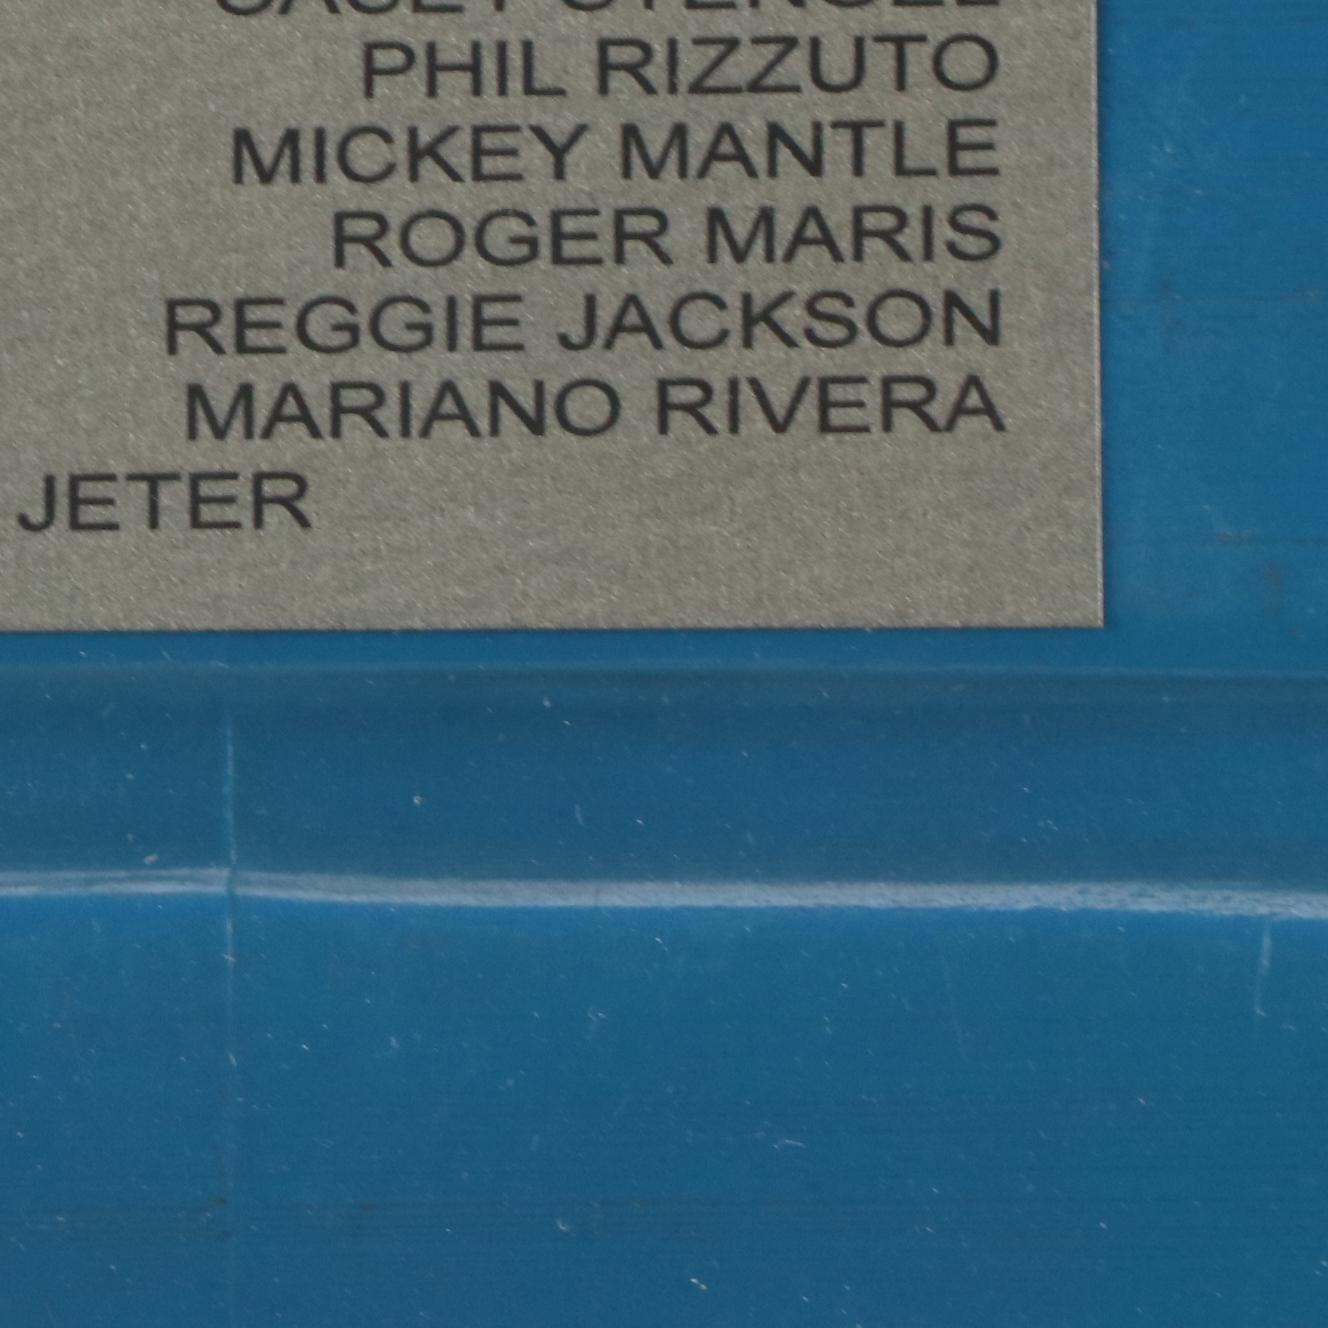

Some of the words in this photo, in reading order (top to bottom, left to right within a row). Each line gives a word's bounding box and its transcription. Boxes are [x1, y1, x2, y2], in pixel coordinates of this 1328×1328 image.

[362, 39, 567, 100] PHIL
[596, 32, 1000, 98] RIZZUTO
[232, 123, 589, 186] MICKEY
[620, 116, 1000, 181] MANTLE
[332, 205, 674, 269] ROGER
[705, 202, 1003, 265] MARIS
[164, 292, 525, 356] REGGIE
[557, 287, 1002, 353] JACKSON
[185, 377, 622, 442] MARIANO
[655, 373, 1006, 437] RIVERA
[16, 470, 311, 534] JETER
